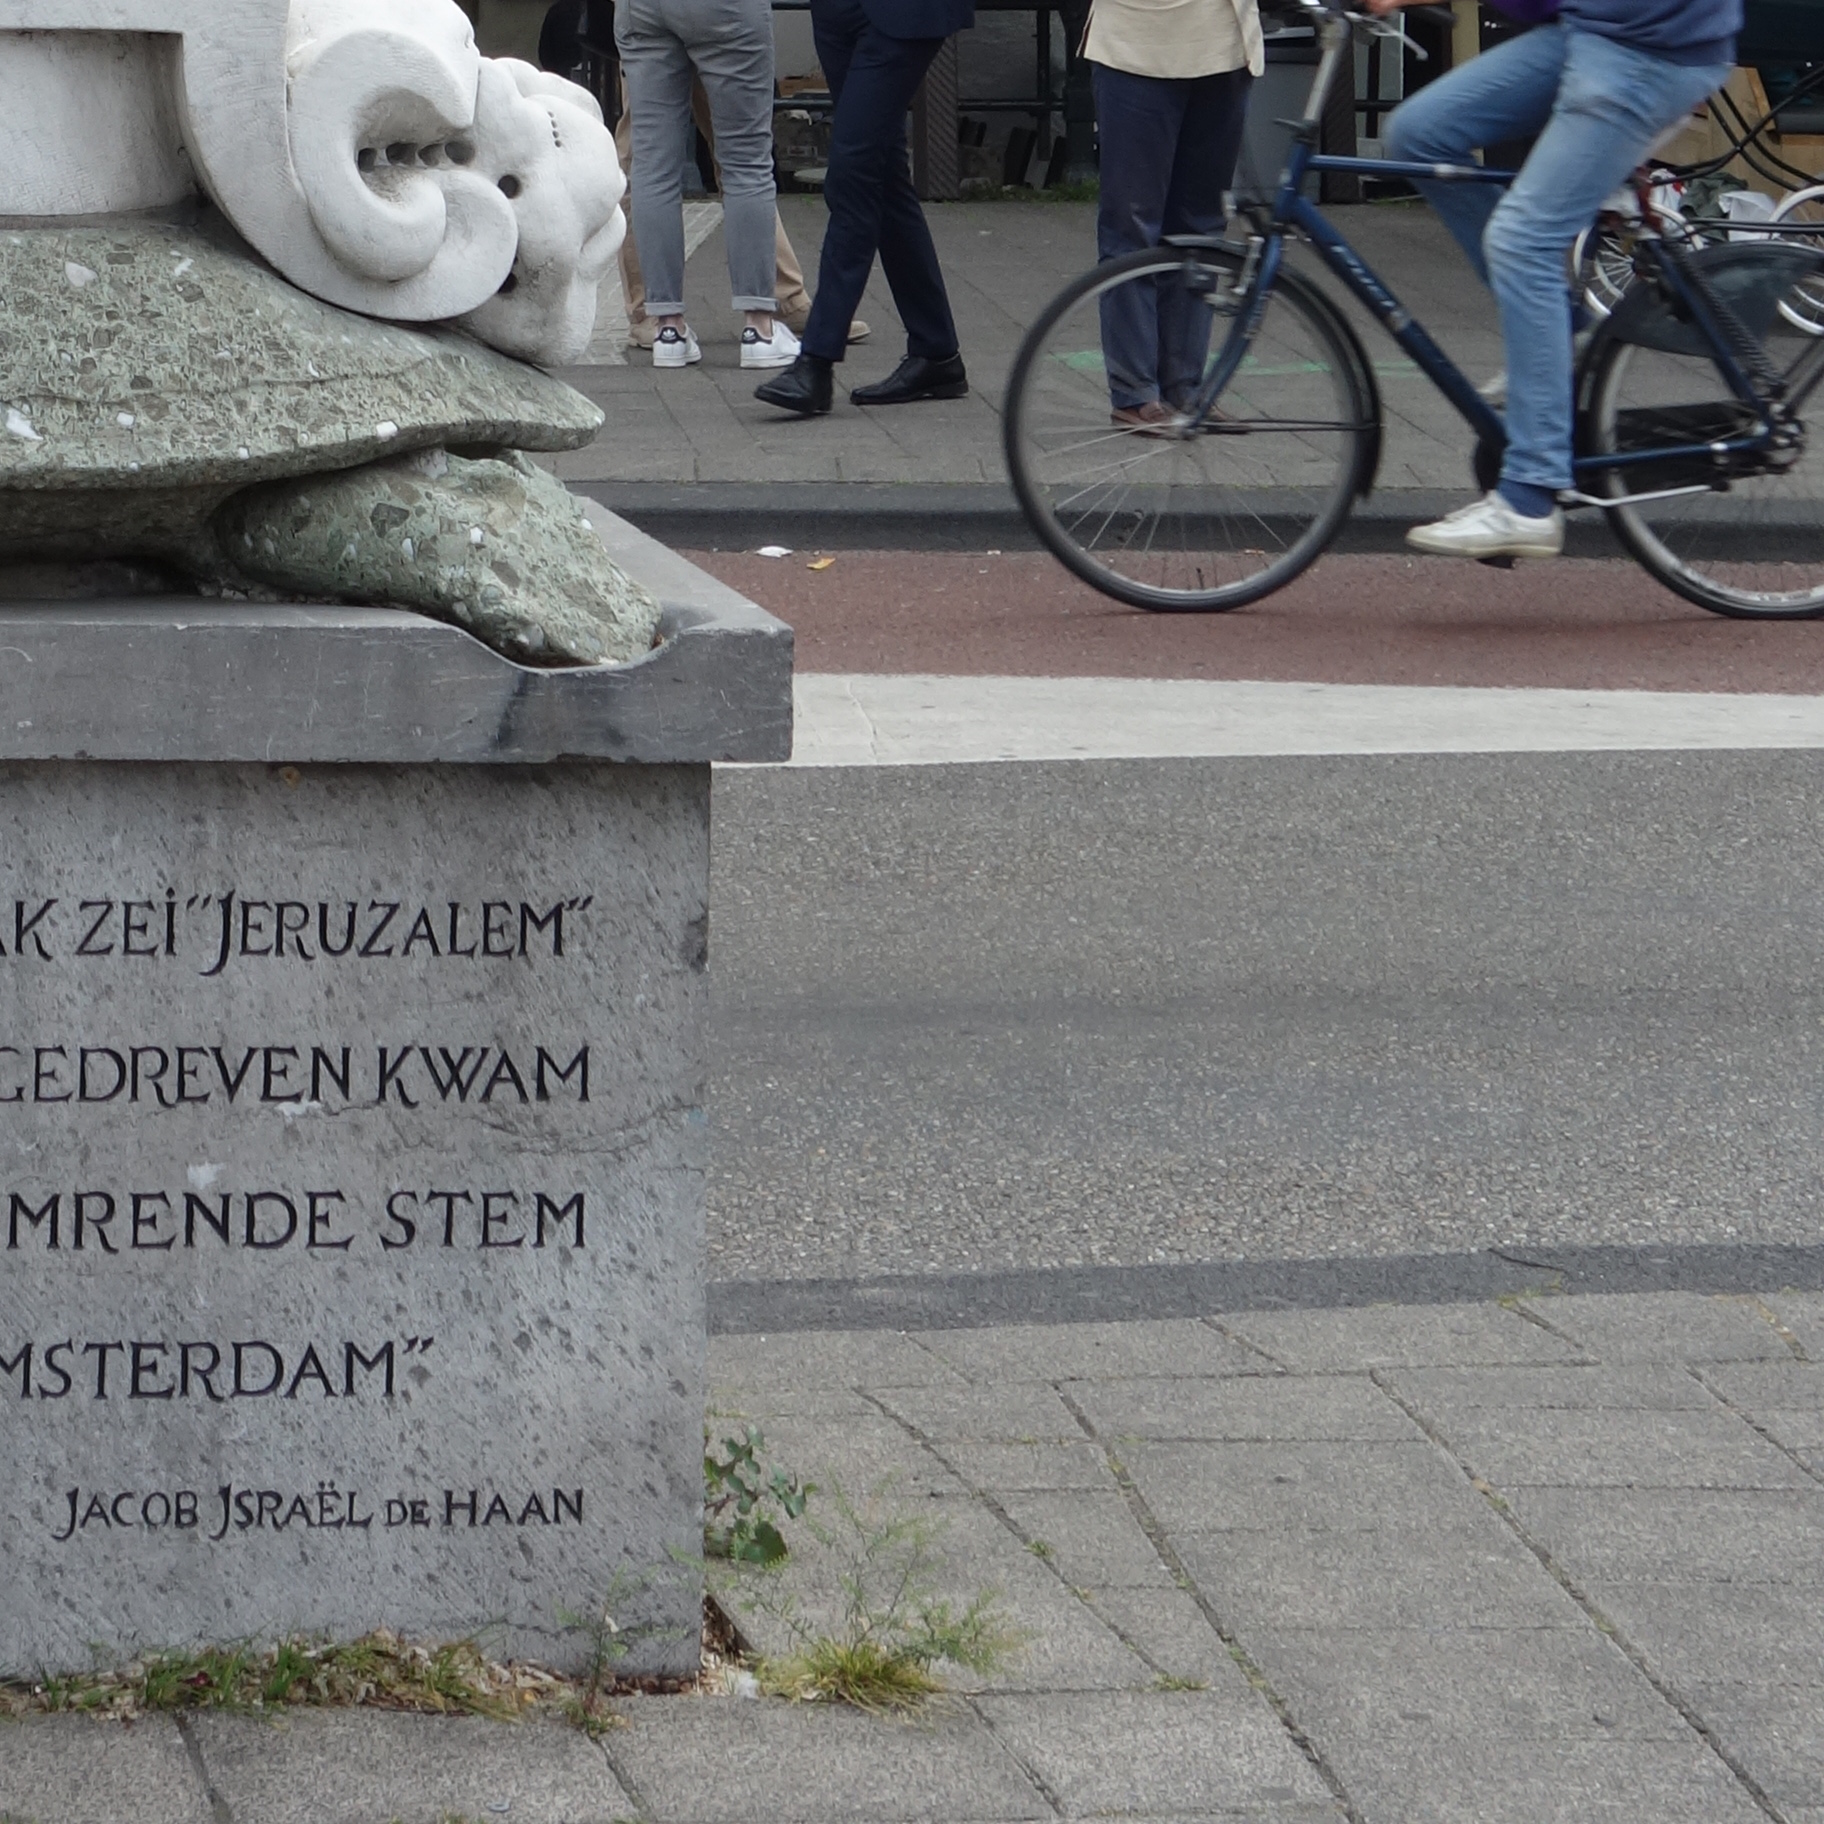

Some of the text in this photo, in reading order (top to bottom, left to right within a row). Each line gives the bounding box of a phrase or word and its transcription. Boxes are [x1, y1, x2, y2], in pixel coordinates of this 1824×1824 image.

[76, 886, 177, 957] ZEI
[376, 1044, 592, 1109] KWAM
[380, 1189, 587, 1251] STEM
[52, 1484, 200, 1543] JACOB
[441, 1488, 585, 1528] HAAN
